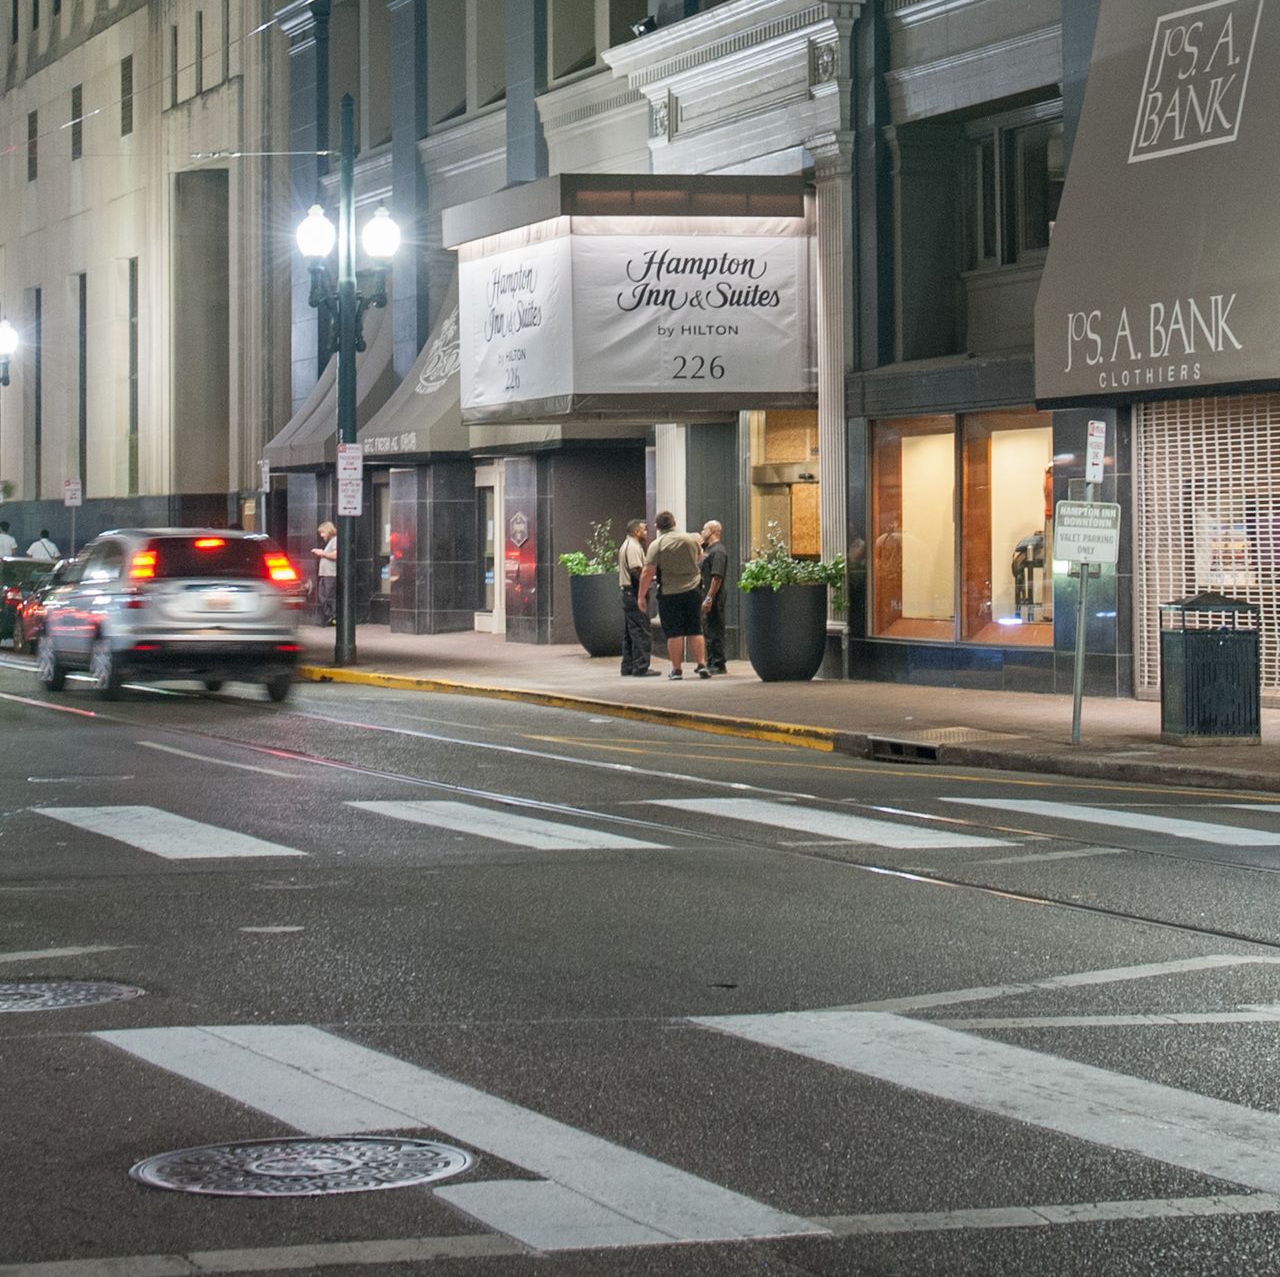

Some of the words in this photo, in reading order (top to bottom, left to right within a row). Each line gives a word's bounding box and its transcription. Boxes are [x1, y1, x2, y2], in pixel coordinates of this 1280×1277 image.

[1203, 12, 1240, 72] A.
[1138, 73, 1236, 147] BANK
[626, 248, 767, 283] Hampton
[487, 264, 538, 308] Hampton
[617, 283, 688, 312] Inn
[689, 290, 706, 310] &
[705, 282, 780, 309] Suites
[484, 307, 506, 343] Inn
[514, 300, 542, 333] Suites
[657, 325, 675, 338] by
[681, 325, 739, 336] HILTON
[1110, 305, 1141, 362] A.
[1149, 293, 1242, 358] BANK
[505, 348, 526, 362] HILTON
[672, 355, 726, 380] 226
[505, 368, 520, 390] 226
[1099, 363, 1201, 388] CLOTHIERS
[1060, 506, 1100, 518] HAMPTON
[1102, 507, 1116, 518] INN
[1063, 516, 1112, 528] DOWNTOWN
[1060, 532, 1081, 542] VALET
[1082, 533, 1114, 544] PARKING
[1077, 545, 1095, 555] ONLY
